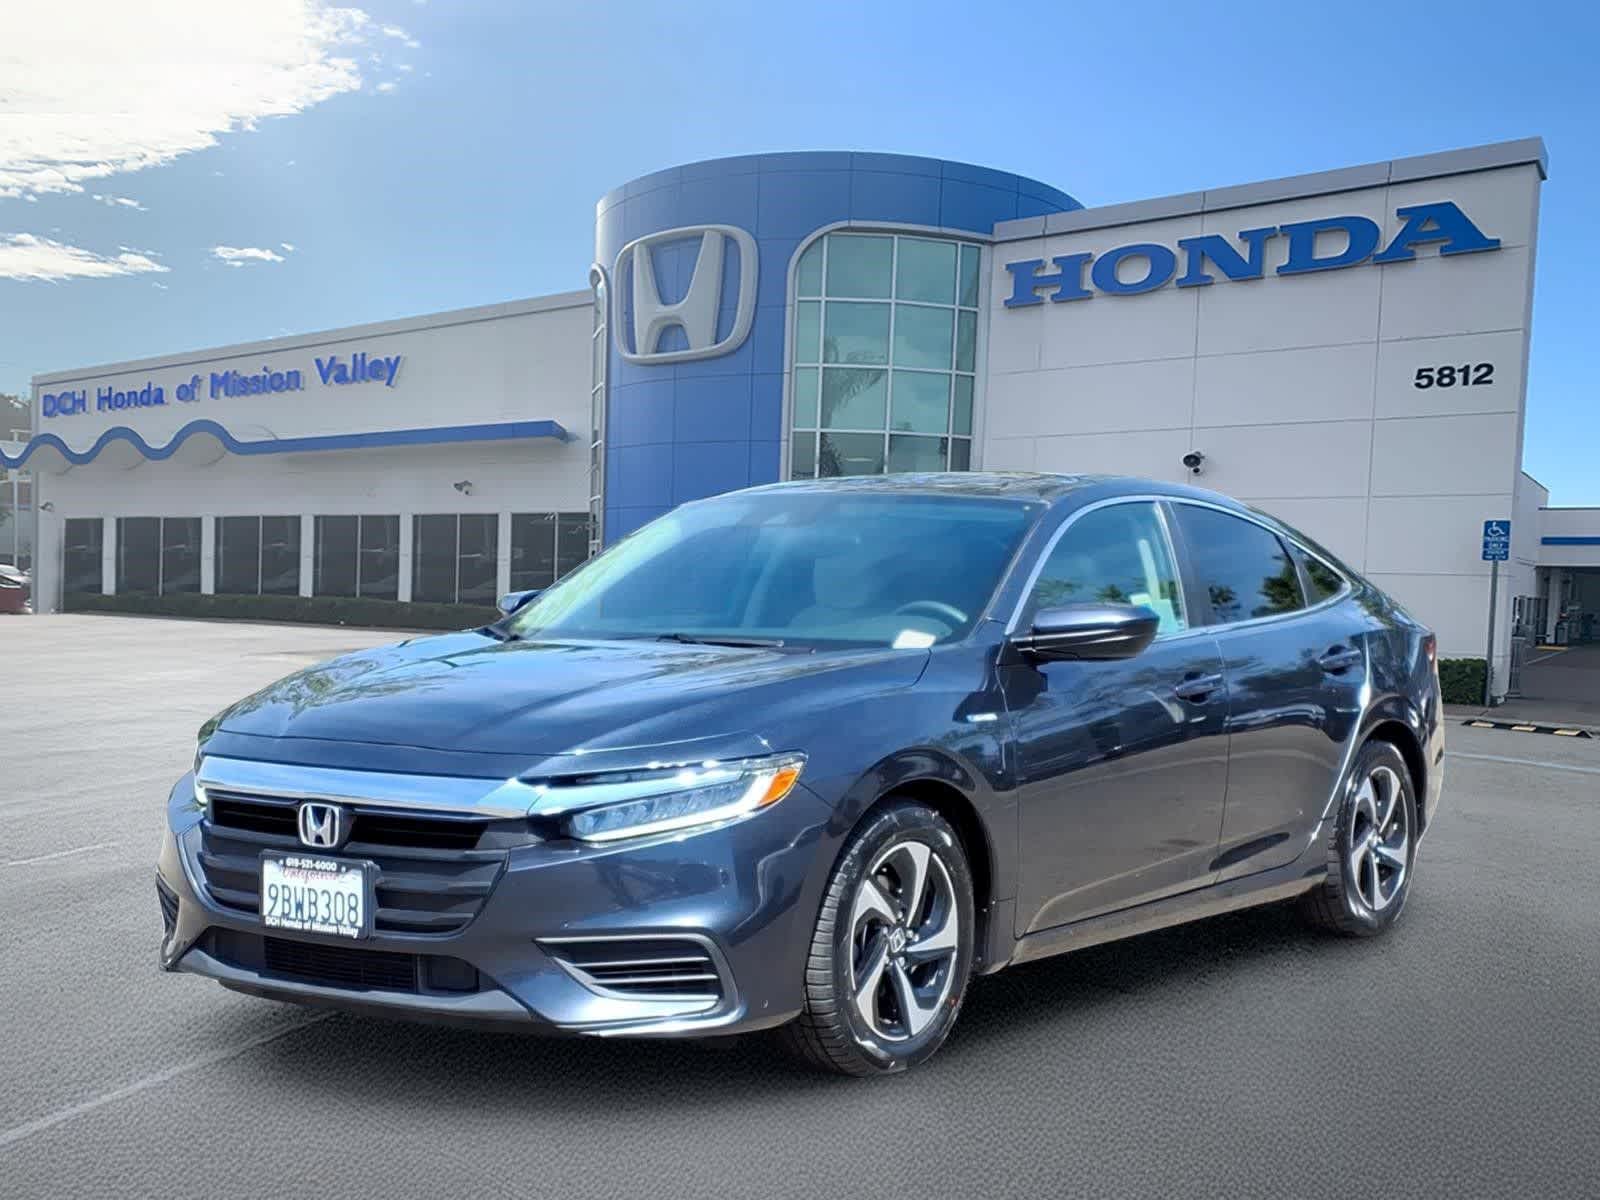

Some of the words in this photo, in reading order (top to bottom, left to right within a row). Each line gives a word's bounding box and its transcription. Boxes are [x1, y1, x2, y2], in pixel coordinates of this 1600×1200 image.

[1003, 200, 1501, 308] HONDA
[42, 389, 87, 417] DCH
[97, 381, 165, 411] Honda
[175, 374, 201, 401] of
[210, 366, 302, 399] Mission
[314, 352, 401, 387] Valley
[1414, 362, 1494, 389] 5812
[268, 883, 359, 925] 9BWB308
